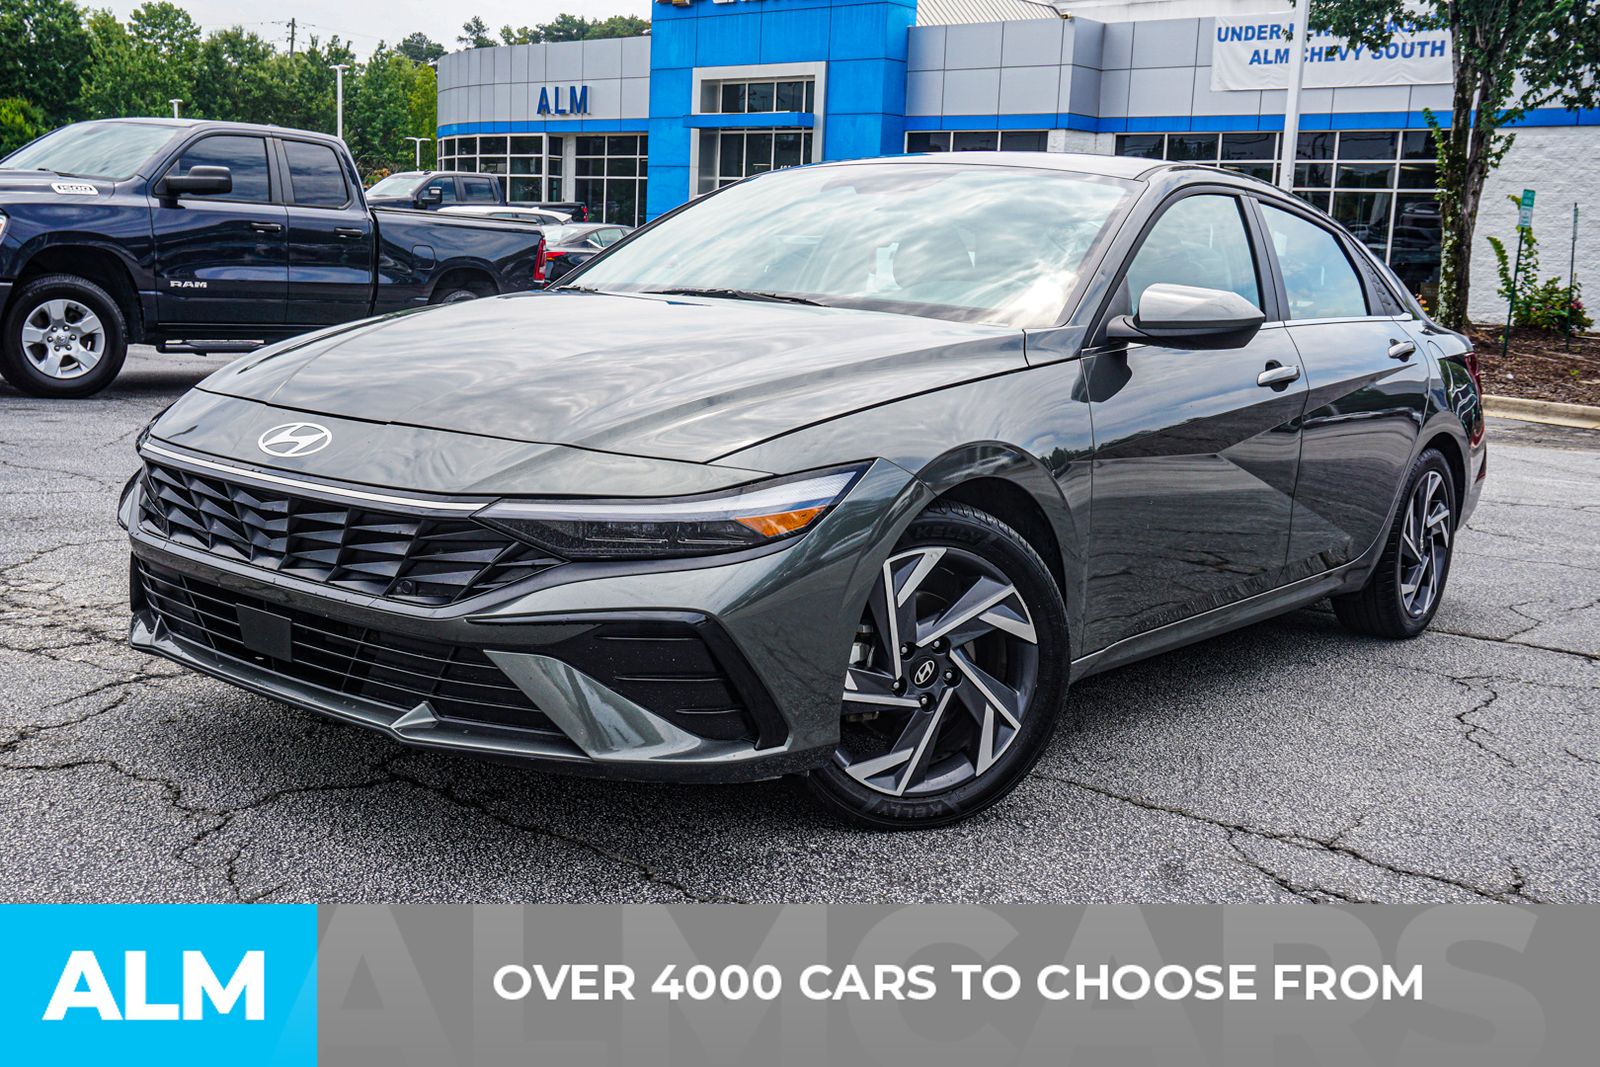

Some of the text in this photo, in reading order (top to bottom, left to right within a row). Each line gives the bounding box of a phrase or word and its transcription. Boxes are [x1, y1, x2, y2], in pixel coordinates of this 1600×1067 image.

[1217, 24, 1281, 42] UNDER
[1248, 48, 1290, 65] ALM
[1371, 40, 1446, 60] SOUTH
[537, 85, 588, 115] ALM
[170, 280, 208, 288] RAM
